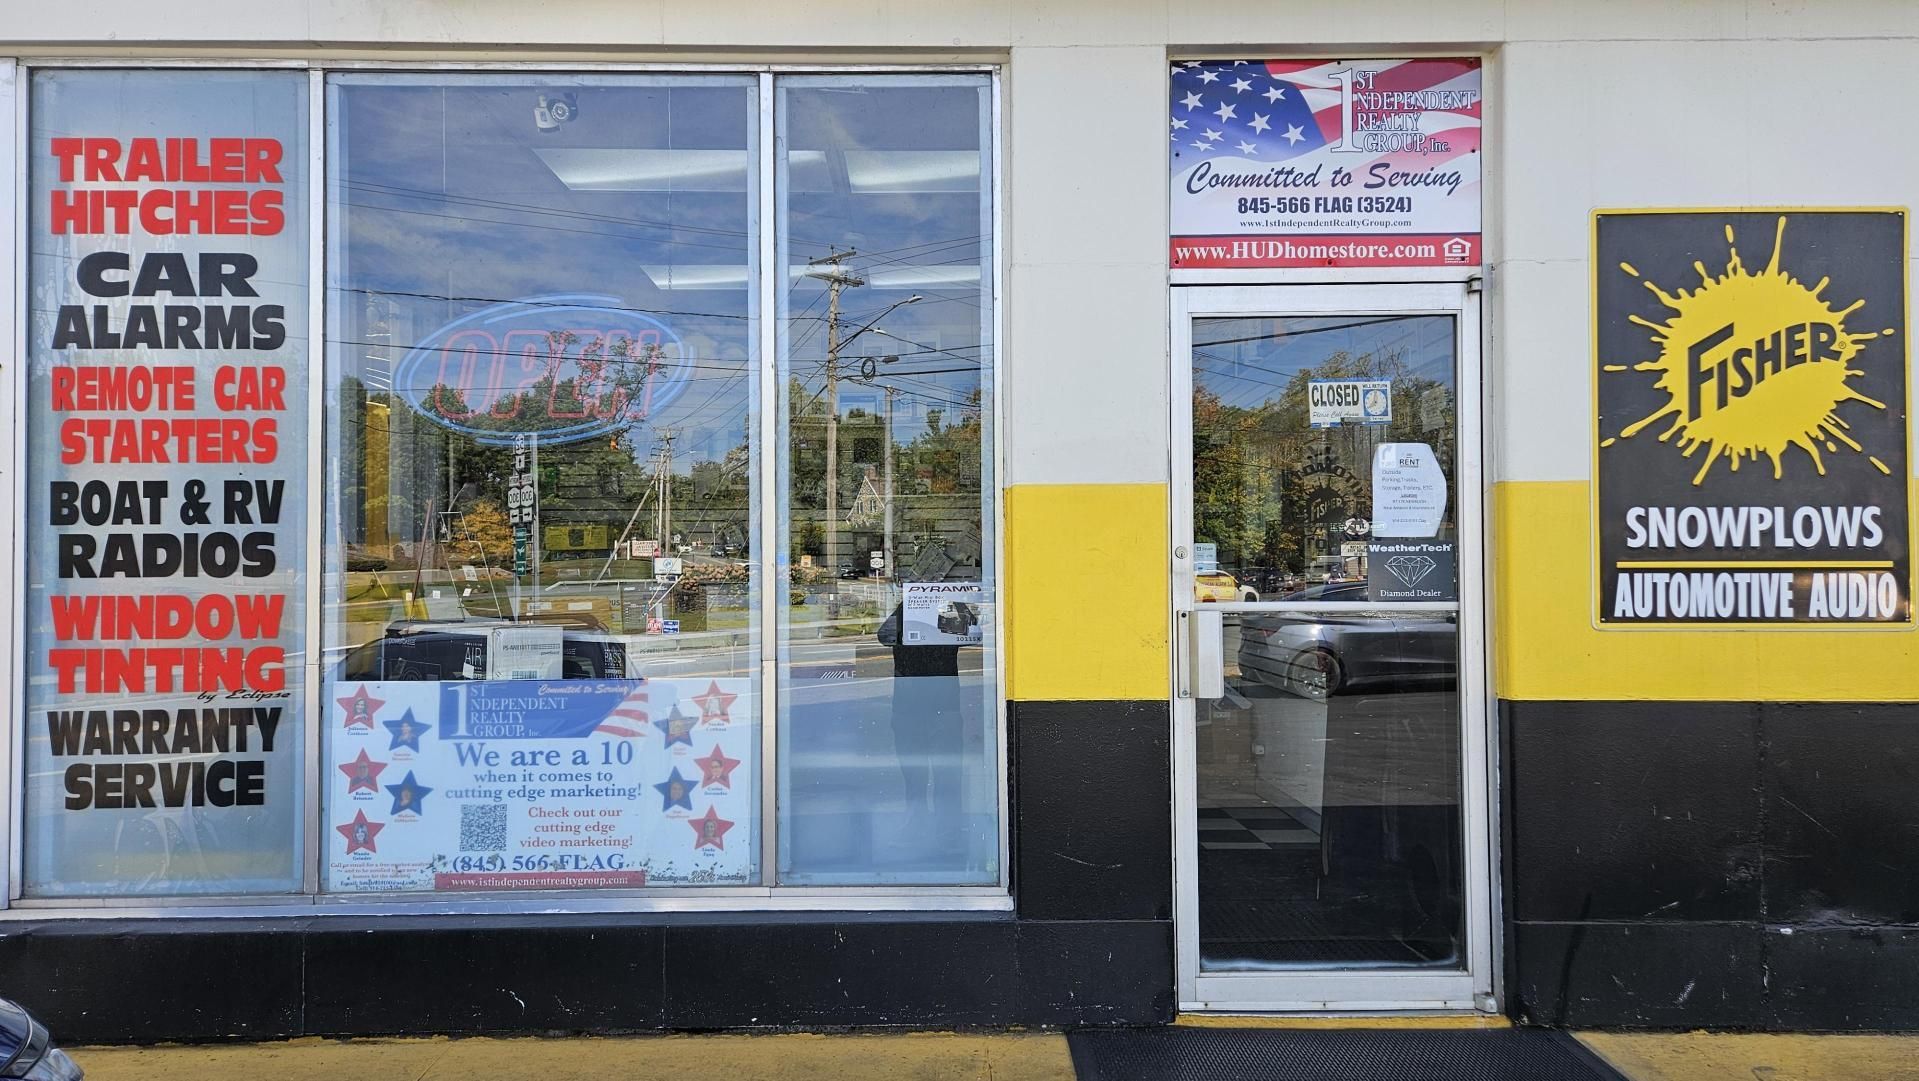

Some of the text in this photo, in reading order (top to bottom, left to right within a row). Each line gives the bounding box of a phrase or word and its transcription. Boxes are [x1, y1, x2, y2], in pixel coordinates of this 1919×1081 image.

[1355, 71, 1378, 90] ST
[1355, 112, 1422, 132] REALTY
[1363, 133, 1451, 156] GROUP, Inc.
[51, 137, 284, 183] TRAILER
[1186, 161, 1462, 195] Committed to Serving
[51, 189, 285, 236] HITCHES
[1238, 196, 1310, 214] 845-566
[1314, 196, 1353, 214] FLAG
[1240, 218, 1412, 228] www.1stIndependentRealtyGroup.com
[1176, 241, 1436, 261] www.HUDhomestore.com
[77, 251, 260, 298] CAR
[52, 305, 286, 350] ALARMS
[434, 328, 661, 420] OPEN
[52, 366, 286, 412] REMOTE CAR
[1312, 384, 1359, 407] CLOSED
[60, 418, 278, 465] STARTERS
[50, 479, 285, 526] BOAT & RV
[1625, 505, 1884, 550] SNOWPLOWS
[58, 532, 276, 578] RADIOS
[1369, 544, 1451, 552] WeatherTech
[908, 585, 982, 593] PYRAMID
[1380, 589, 1441, 597] Diamond Dealer
[1614, 572, 1898, 619] AUTOMOTIVE AUDIO
[50, 594, 285, 641] WINDOW
[465, 647, 482, 666] AIR
[49, 646, 285, 694] TINTING
[197, 689, 291, 704] by Eclipse
[470, 685, 488, 697] ST
[538, 684, 630, 696] Committed to Serving
[470, 711, 526, 724] REALTY
[47, 707, 282, 756] WARRANTY
[528, 728, 541, 737] Inc.
[454, 740, 633, 767] We are a 10
[64, 760, 265, 811] SERVICE
[474, 769, 613, 783] when it comes to
[445, 782, 642, 801] cutting edge marketing!
[528, 806, 623, 818] Check out our
[534, 821, 616, 834] cutting edge
[520, 835, 633, 849] video marketing!
